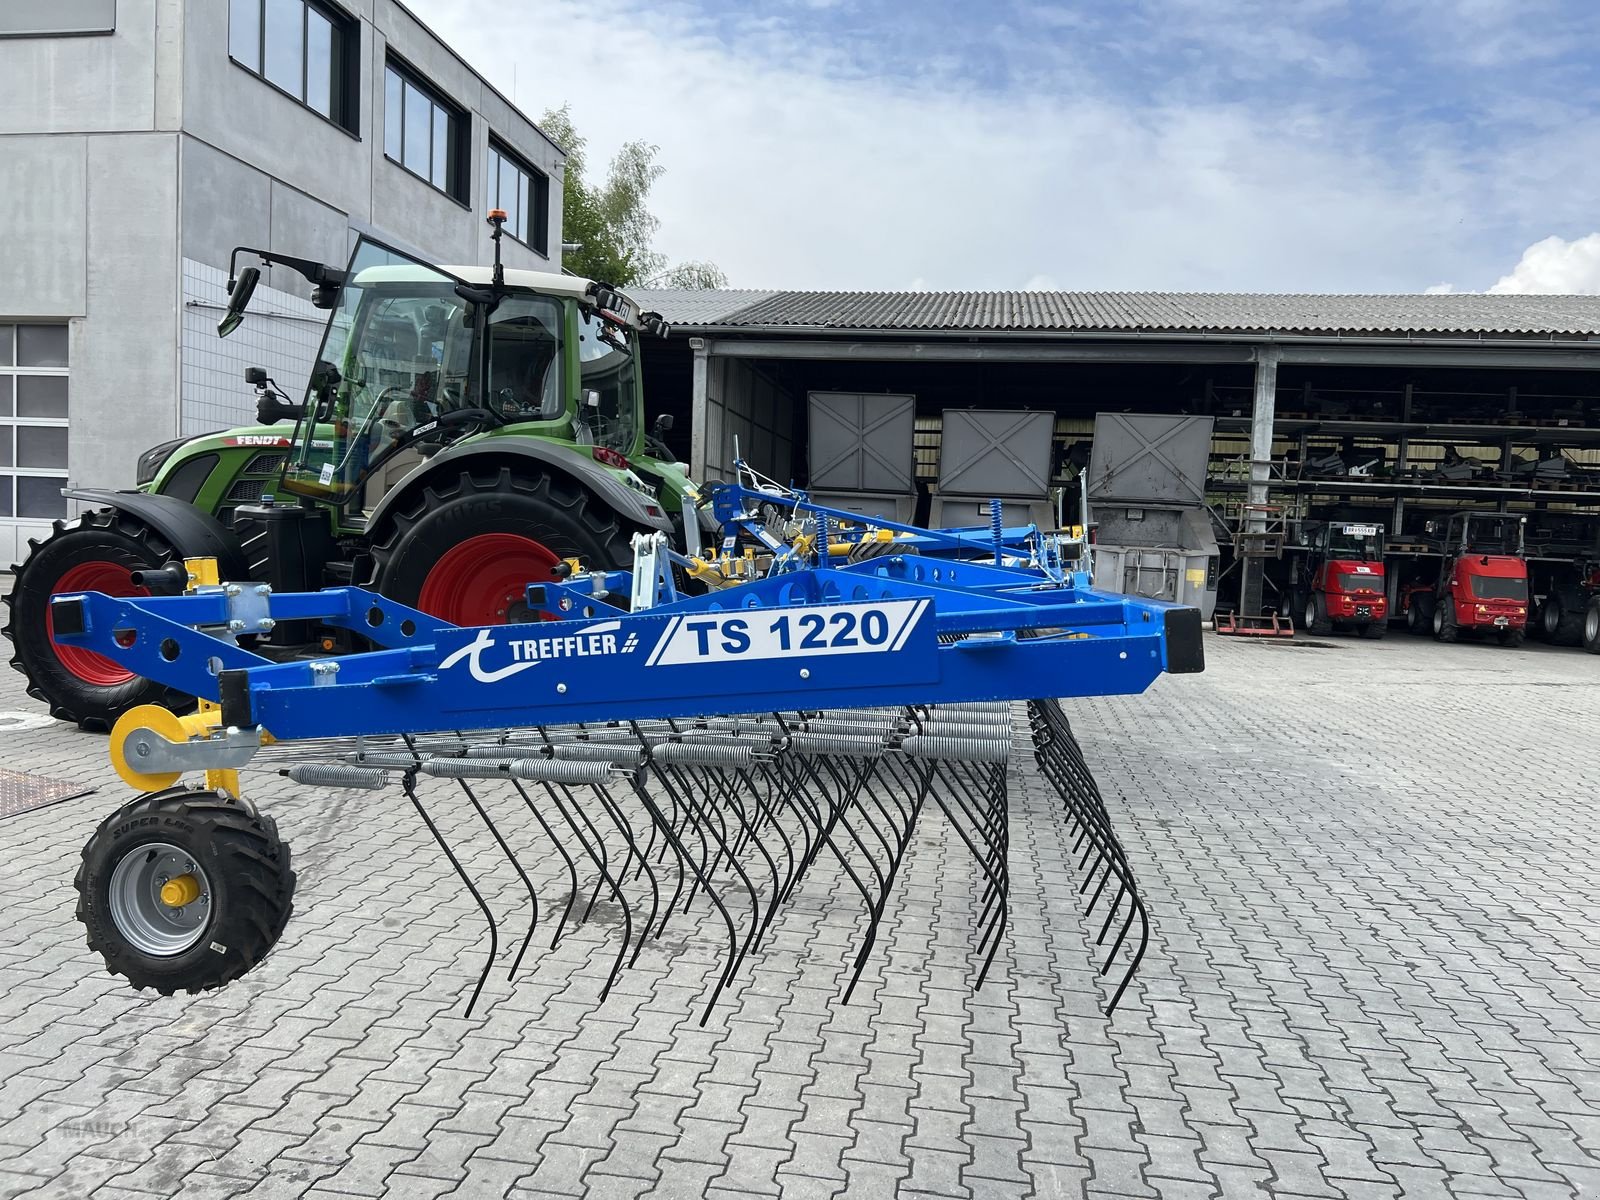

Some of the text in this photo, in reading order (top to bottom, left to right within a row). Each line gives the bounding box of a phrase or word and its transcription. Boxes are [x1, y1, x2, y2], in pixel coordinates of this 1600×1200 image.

[236, 435, 282, 445] FENDT
[687, 609, 889, 655] TS 1220
[508, 634, 617, 661] TREFFLER
[113, 816, 160, 840] SUPER
